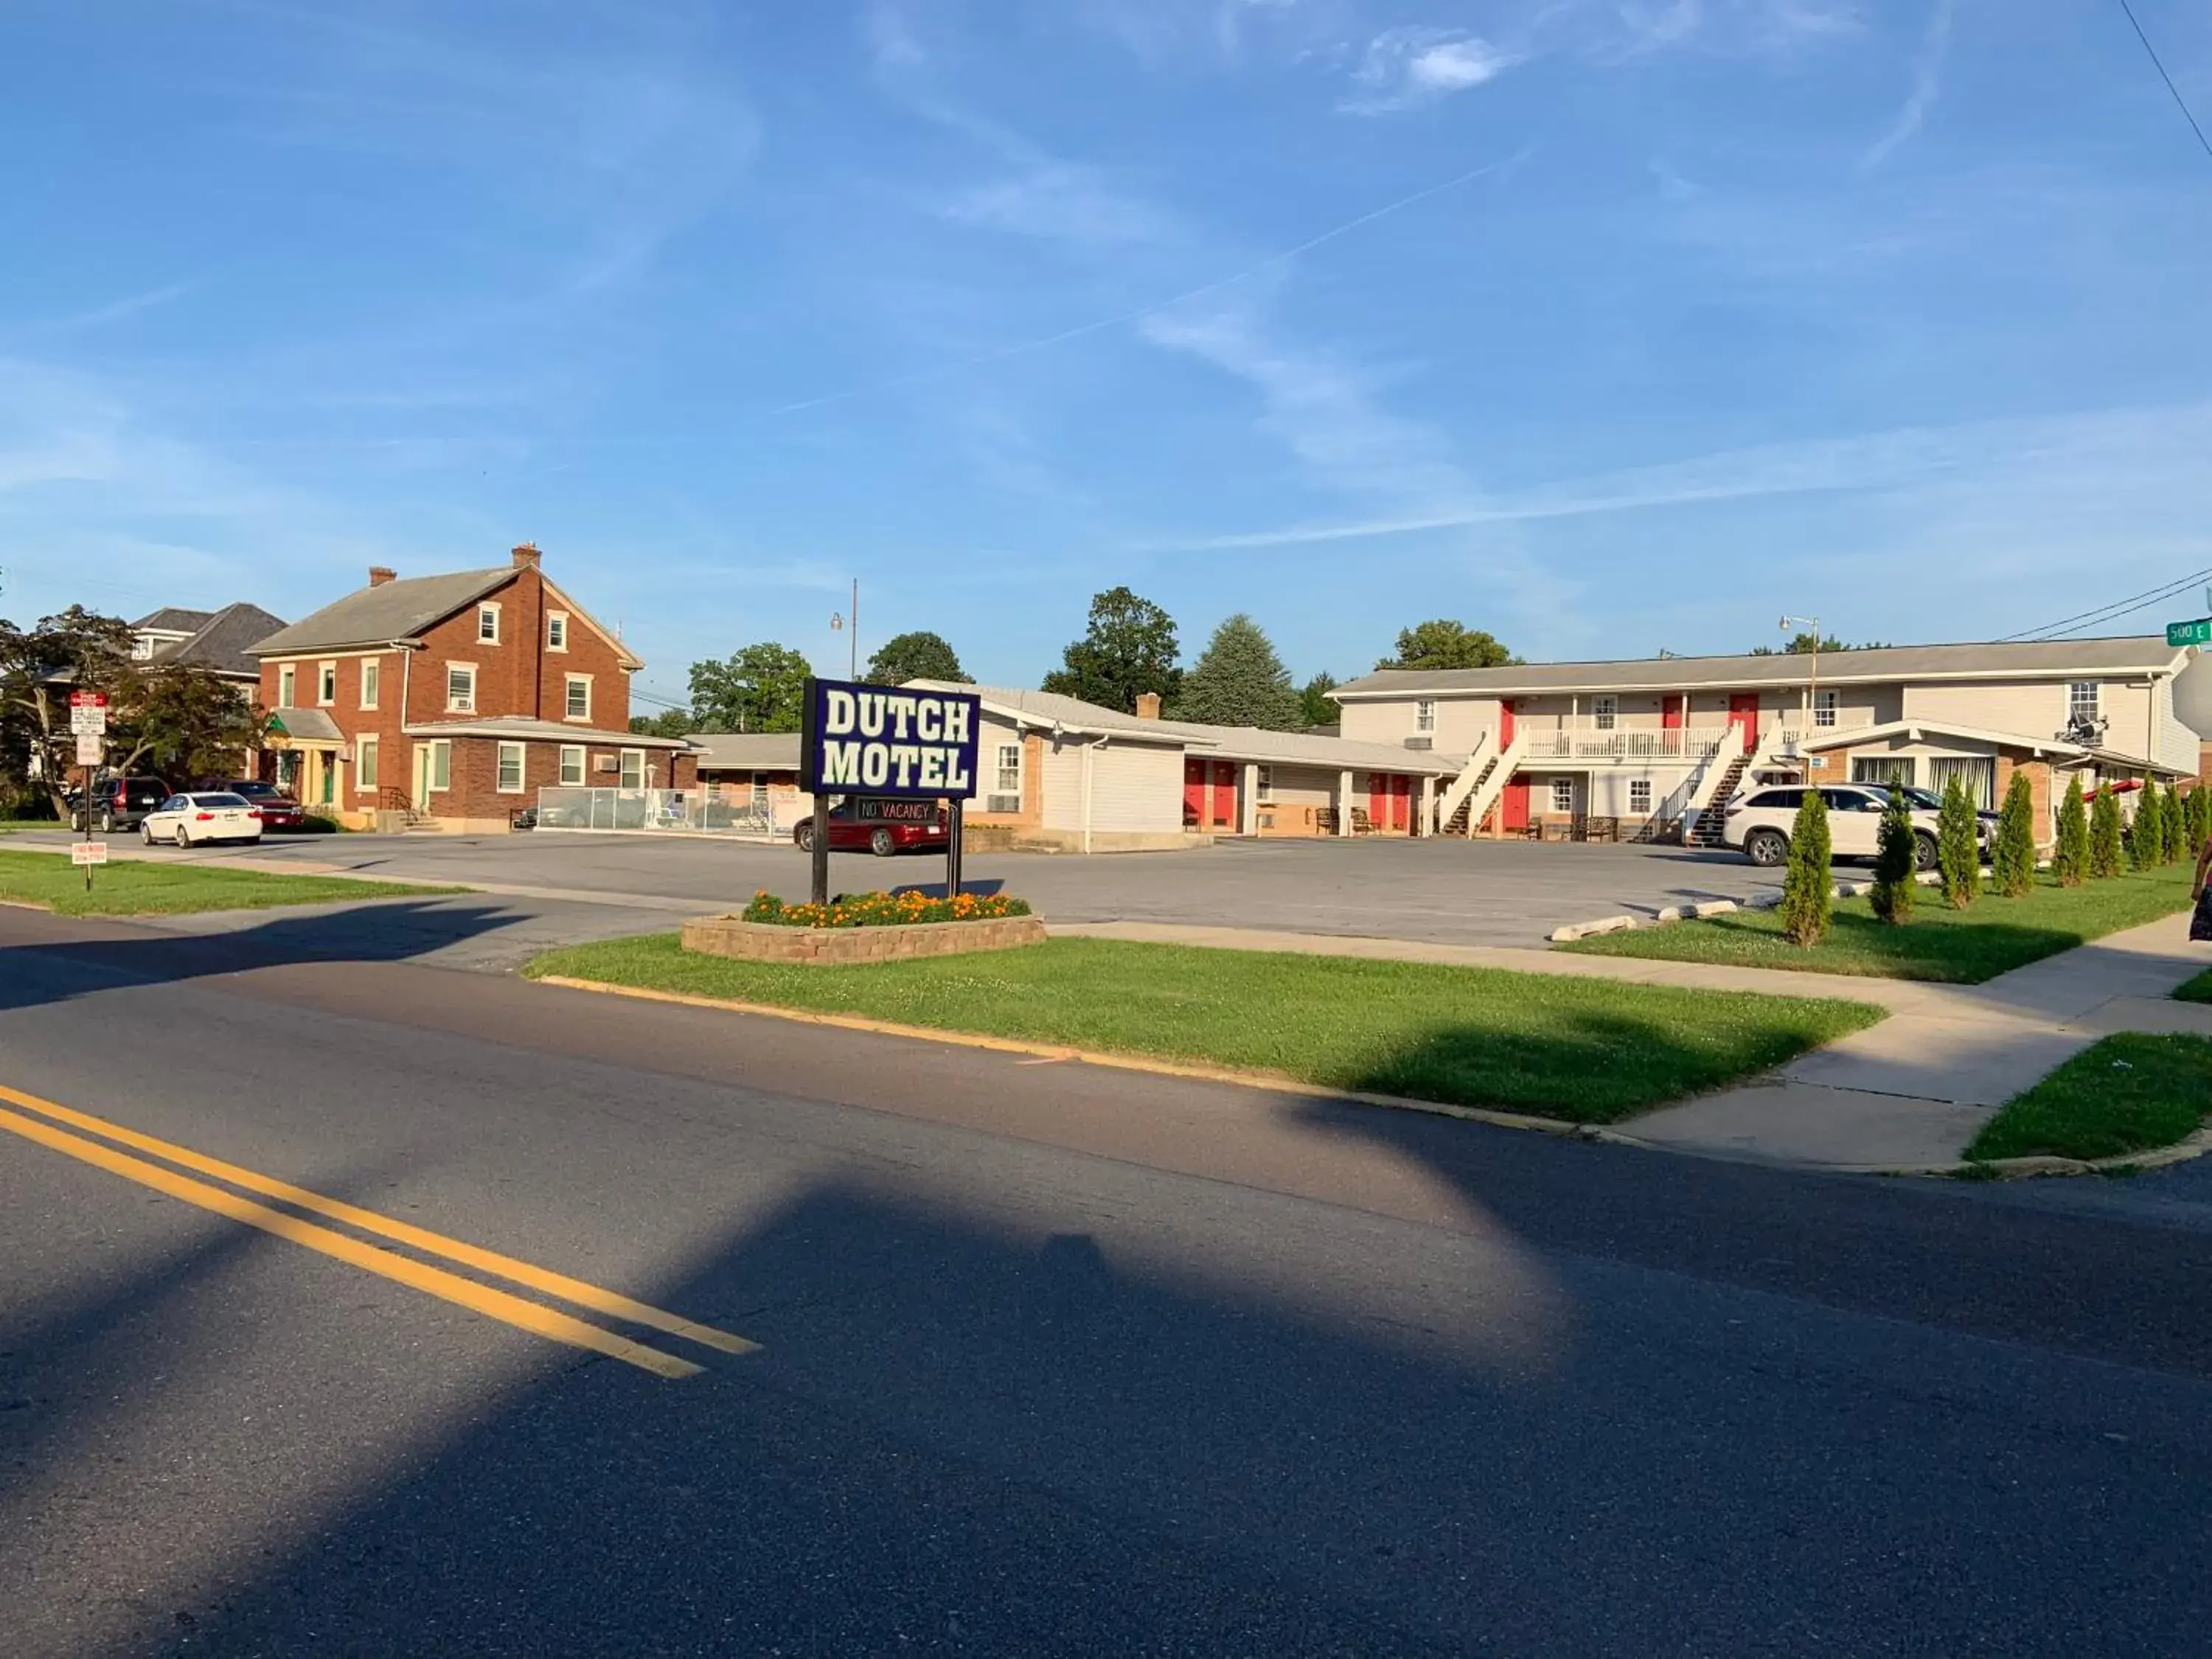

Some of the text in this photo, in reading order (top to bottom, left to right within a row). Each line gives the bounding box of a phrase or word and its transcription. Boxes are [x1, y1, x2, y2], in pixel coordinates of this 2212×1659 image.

[2170, 625, 2205, 639] 500 E
[825, 689, 970, 743] DUTCH
[822, 739, 969, 790] MOTEL
[861, 801, 929, 819] NO VACANCY
